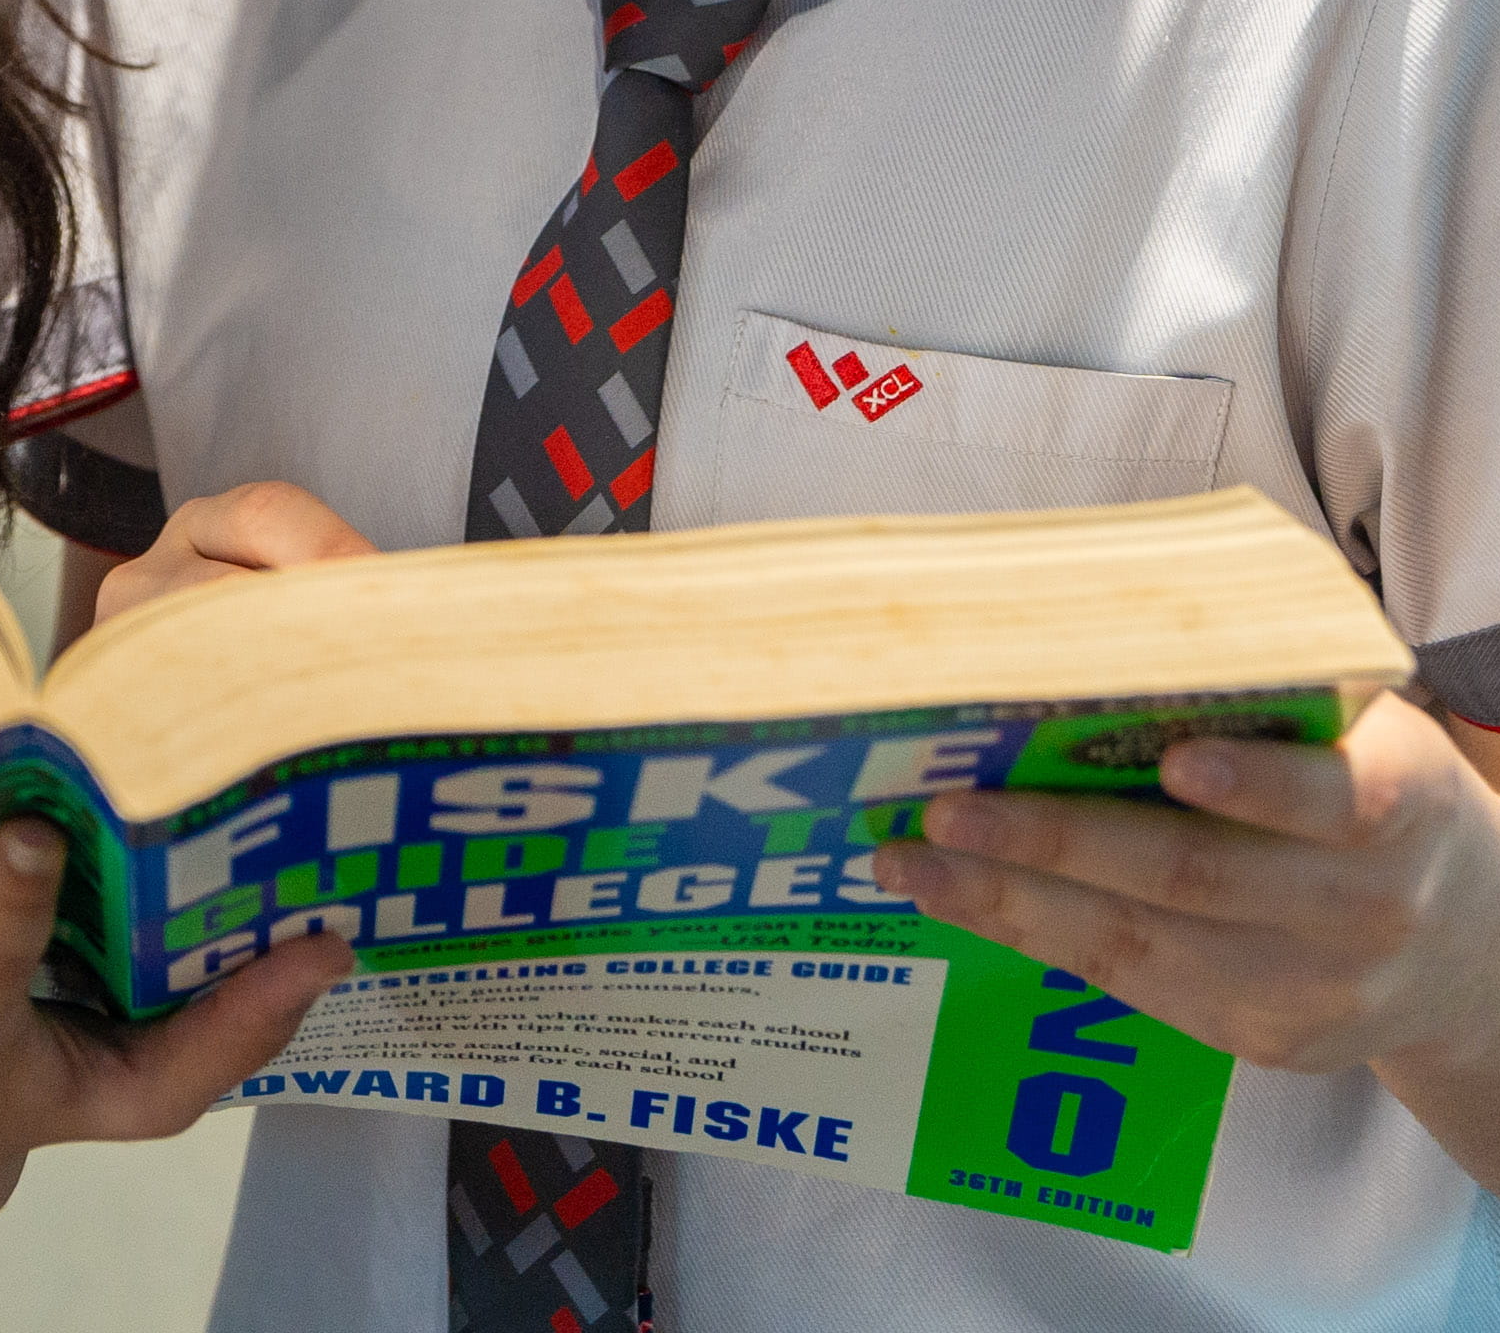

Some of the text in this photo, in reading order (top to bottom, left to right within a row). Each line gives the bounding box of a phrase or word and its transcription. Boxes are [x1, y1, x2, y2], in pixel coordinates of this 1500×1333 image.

[861, 373, 915, 413] XCL
[165, 727, 1002, 912] FISKE
[162, 822, 667, 952] GUIDE
[810, 934, 918, 953] Today
[605, 958, 775, 978] COLLEGE
[790, 960, 914, 986] GUIDE
[574, 1022, 639, 1036] from
[645, 1027, 746, 1046] current
[748, 1036, 863, 1059] students
[606, 1013, 690, 1027] makes
[696, 1016, 756, 1033] each
[763, 1023, 853, 1042] school
[527, 1053, 568, 1066] for
[574, 1058, 632, 1073] each
[639, 1063, 727, 1083] school
[598, 1048, 681, 1065] social,
[688, 1054, 738, 1070] and
[214, 1069, 854, 1163] DWARD B. FISKE
[947, 1168, 1156, 1229] 36TH EDITION
